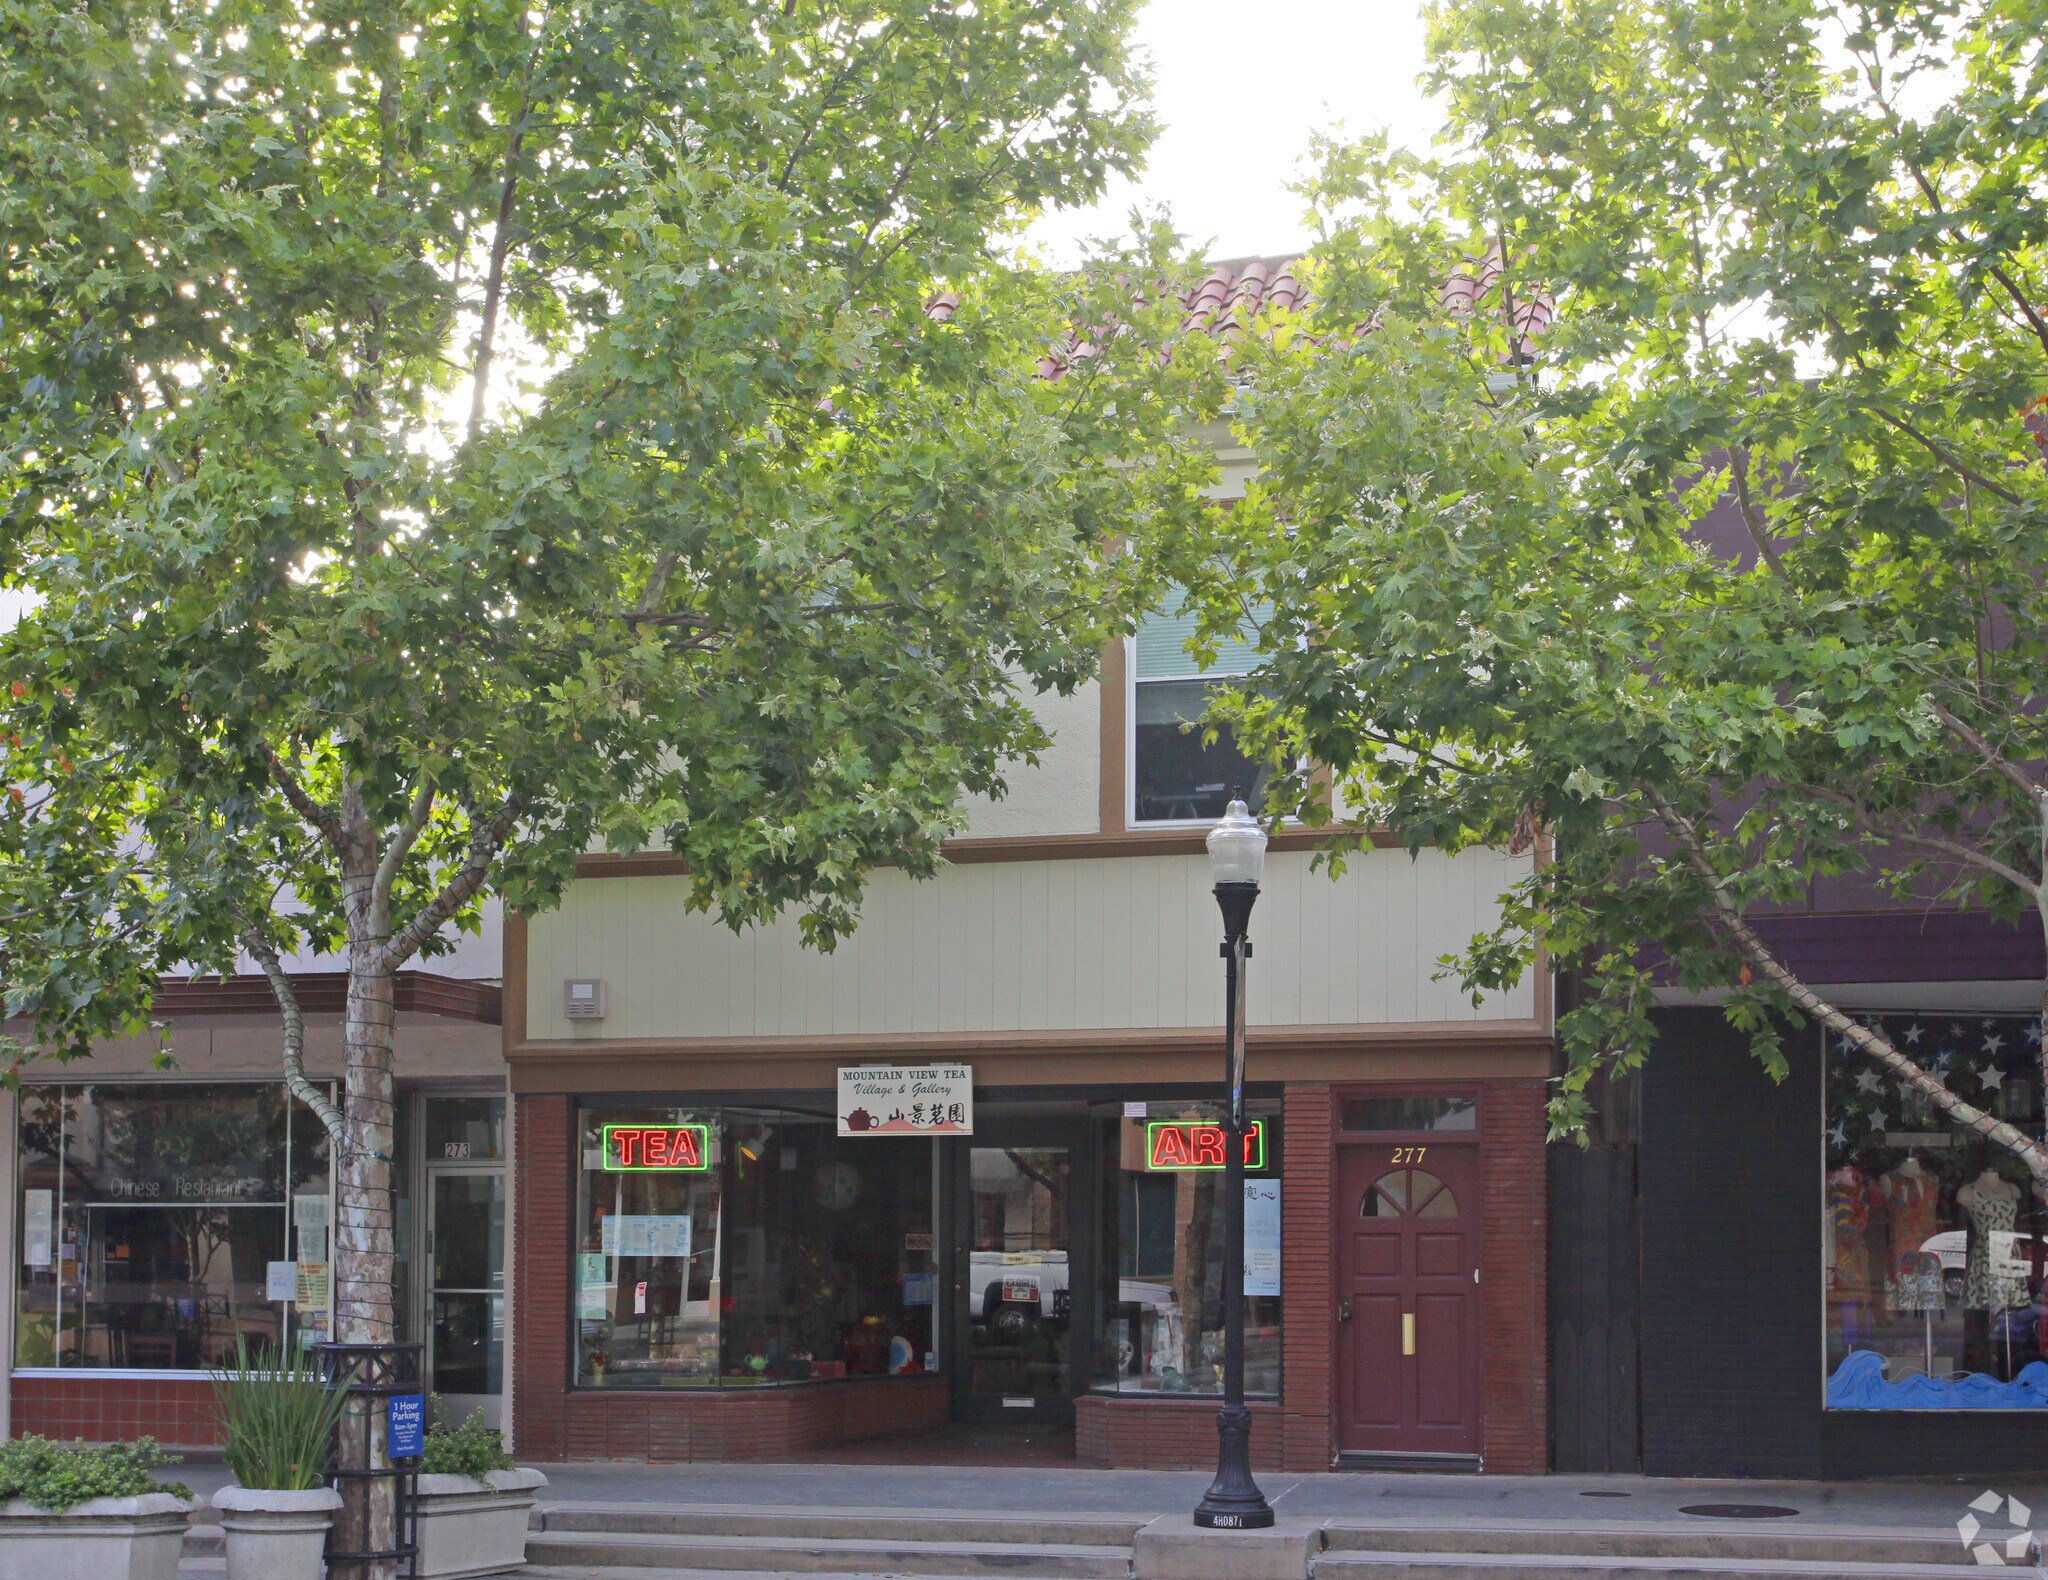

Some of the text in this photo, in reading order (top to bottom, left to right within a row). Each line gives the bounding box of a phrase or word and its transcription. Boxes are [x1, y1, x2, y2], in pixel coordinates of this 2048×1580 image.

[843, 1069, 967, 1081] MOUNTAIN VIEW TEA
[853, 1082, 952, 1098] Village & Gallery
[888, 1102, 965, 1125] 山景茗園
[446, 1143, 470, 1158] 273
[613, 1129, 698, 1166] TEA
[1391, 1147, 1427, 1164] 277
[110, 1175, 241, 1198] Chinese Restaurant
[394, 1401, 419, 1411] 1 Hour
[392, 1410, 420, 1422] Parking
